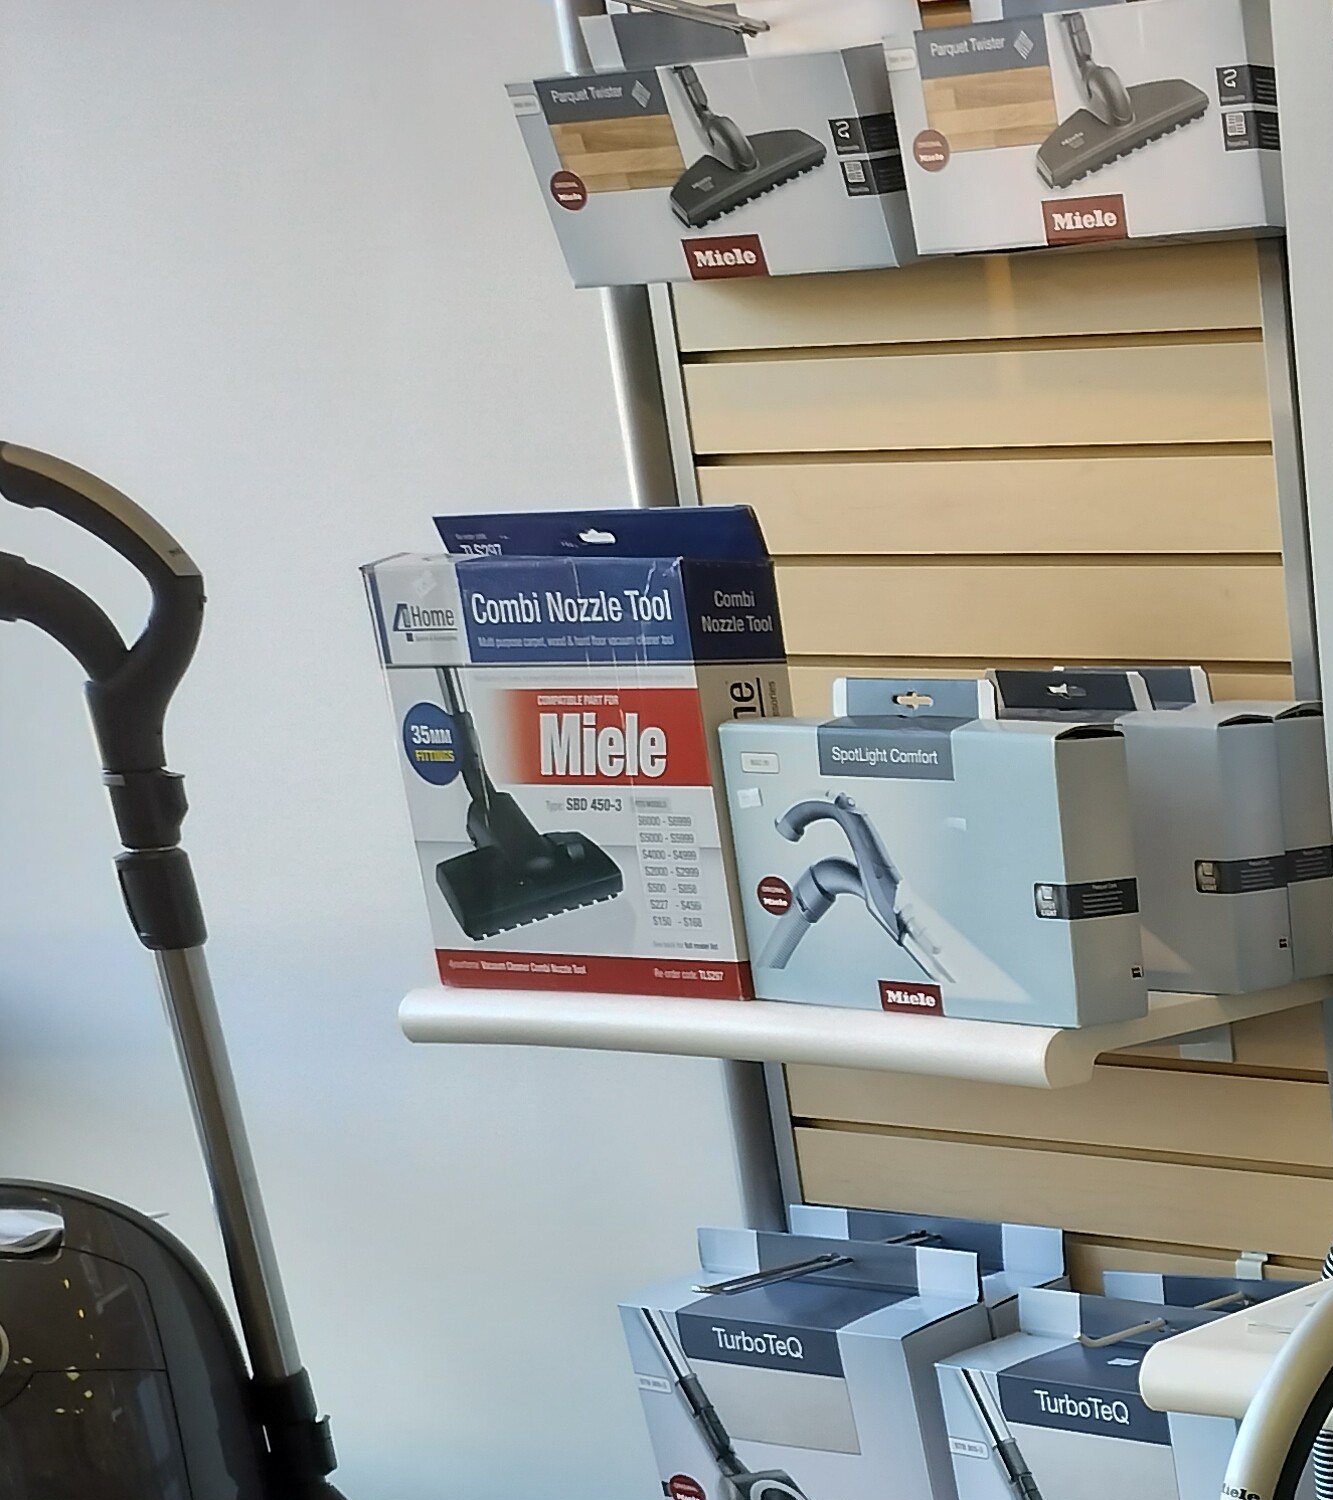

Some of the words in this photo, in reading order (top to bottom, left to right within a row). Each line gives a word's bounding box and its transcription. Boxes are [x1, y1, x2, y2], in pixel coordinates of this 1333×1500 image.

[930, 39, 969, 57] Parquet
[970, 36, 1006, 52] Twister
[551, 88, 588, 103] Parquet
[590, 86, 622, 99] Twister
[1052, 209, 1117, 231] Miele
[694, 248, 757, 267] Miele
[471, 591, 541, 624] Combi
[549, 591, 622, 622] Nozzle
[624, 588, 672, 621] Tool
[714, 590, 755, 607] Combi
[701, 616, 745, 632] Nozzle
[745, 615, 773, 632] Tool
[410, 725, 453, 745] 35MM
[539, 712, 668, 777] Miele
[832, 746, 887, 766] SpotLight
[890, 748, 939, 765] Comfort
[566, 797, 587, 811] SBD
[590, 798, 622, 811] 450-3
[886, 988, 937, 1007] Miele
[712, 1327, 804, 1359] TurboTeQ
[1033, 1389, 1130, 1425] TurboTeQ
